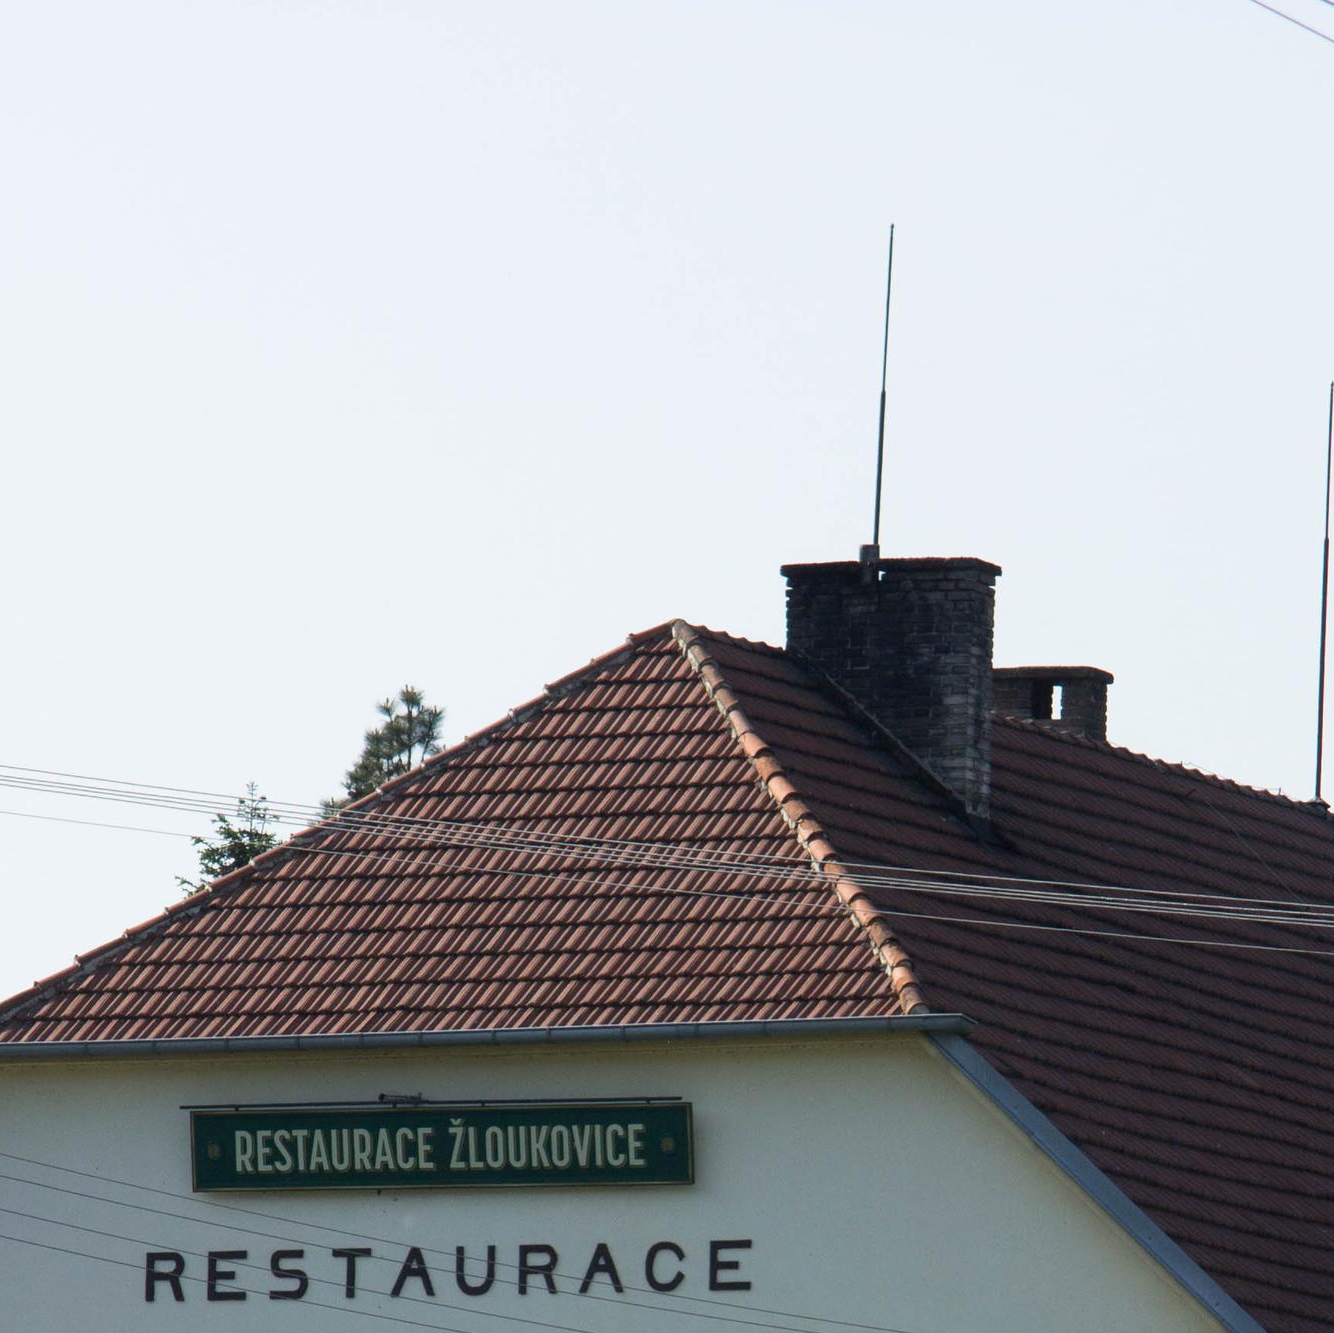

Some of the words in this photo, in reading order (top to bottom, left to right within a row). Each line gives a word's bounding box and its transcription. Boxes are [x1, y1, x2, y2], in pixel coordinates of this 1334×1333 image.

[235, 1128, 434, 1173] RESTAURACE
[449, 1118, 646, 1169] ŽLOUKOVICE
[144, 1239, 752, 1302] RESTAURACE
